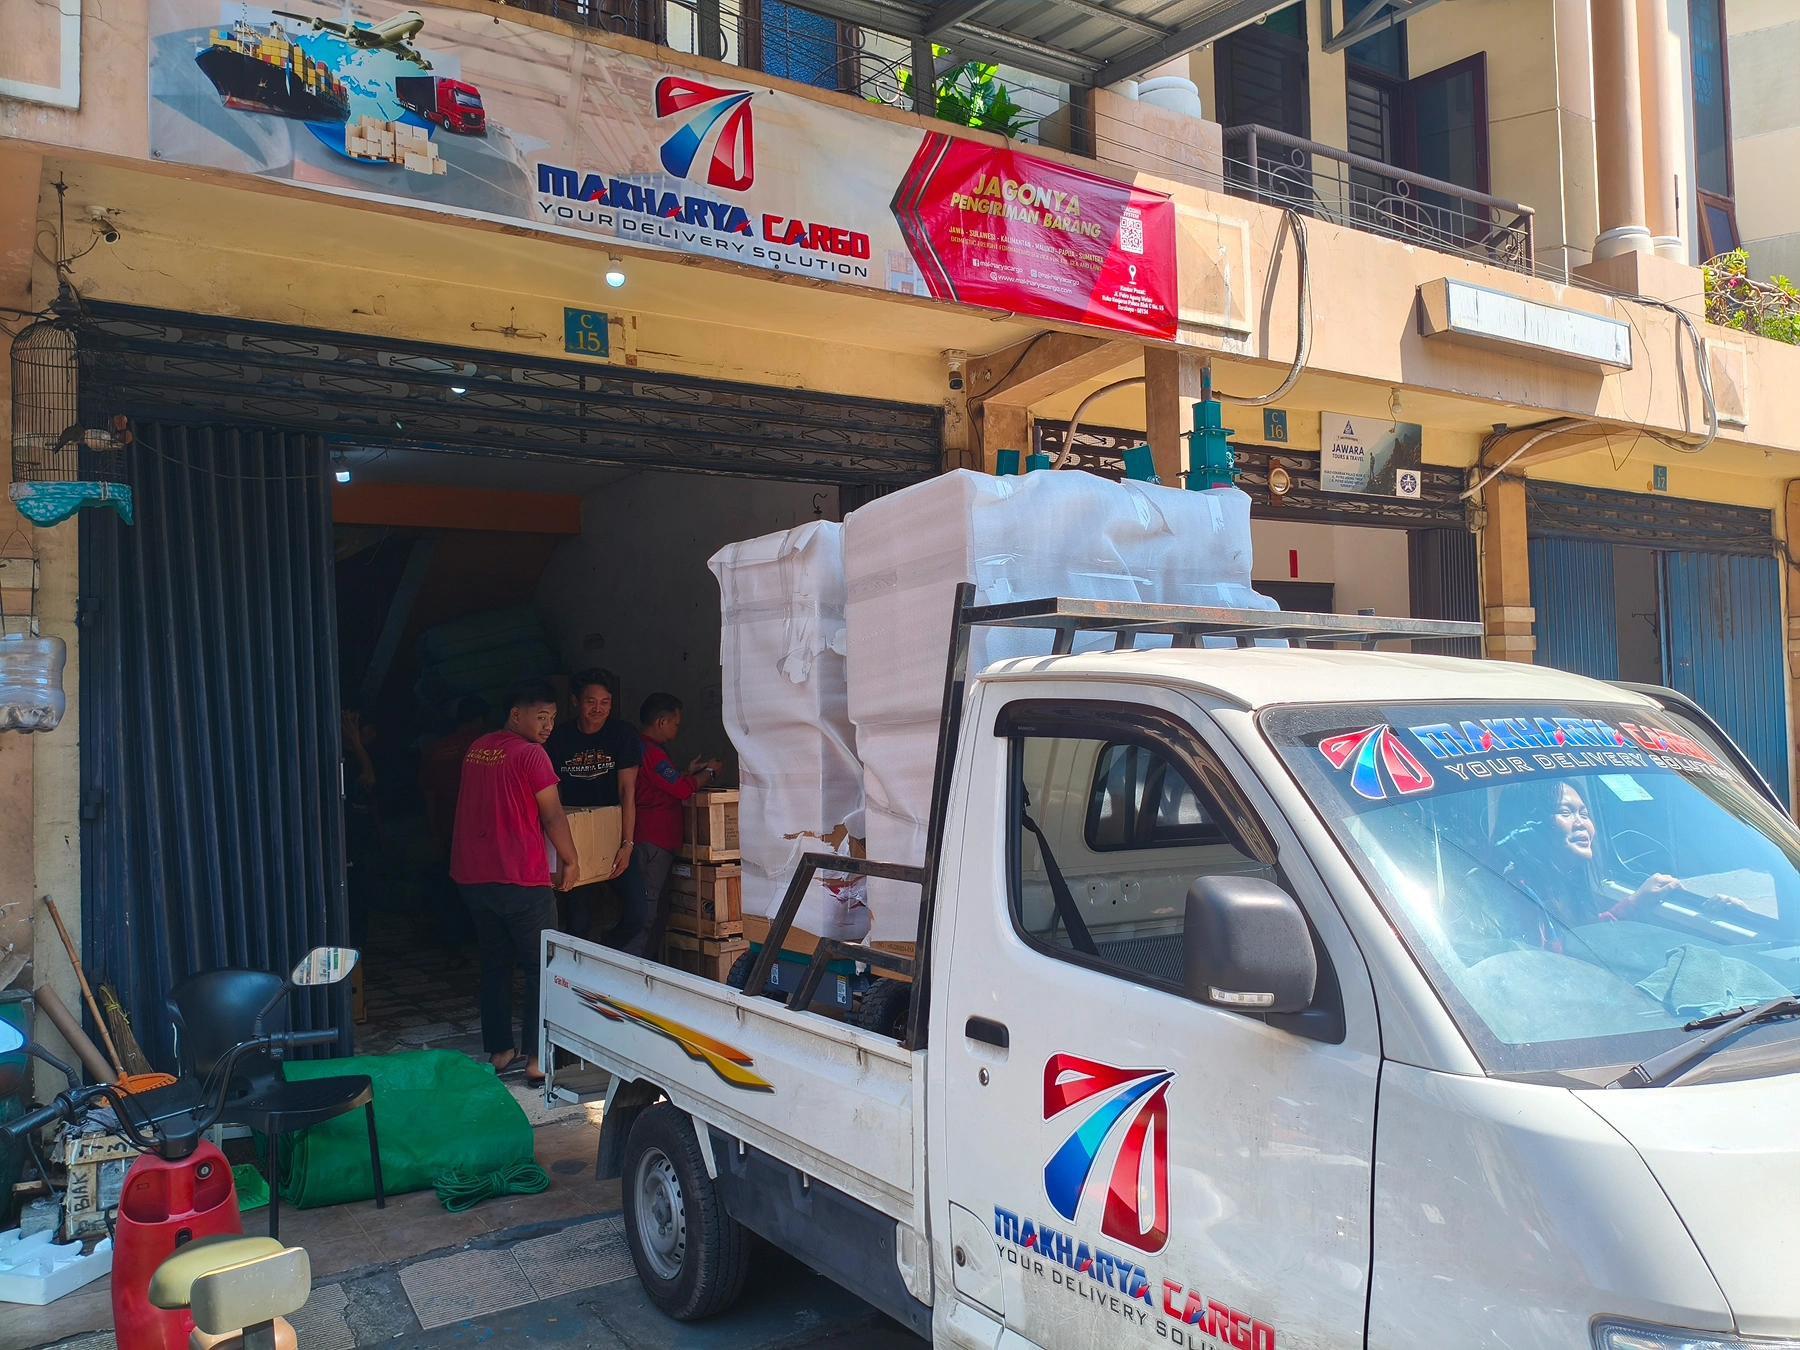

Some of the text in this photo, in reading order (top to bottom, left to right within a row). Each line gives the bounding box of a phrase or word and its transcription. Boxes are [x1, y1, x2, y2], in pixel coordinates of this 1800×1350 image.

[973, 173, 1081, 217] JAGONYA
[537, 163, 871, 260] MAKHARYA CARGO
[950, 192, 1101, 238] PENGIRIMAN BARANG
[538, 201, 867, 278] YOUR DELIVERY SOLUTION
[949, 226, 965, 235] JAWA
[969, 229, 996, 240] SULAWESI
[1059, 248, 1075, 257] PAPUA
[580, 314, 594, 329] C
[575, 330, 601, 352] 15
[1270, 424, 1284, 439] 16
[1271, 412, 1279, 423] C
[1332, 443, 1365, 456] JAWARA
[1657, 476, 1666, 489] 17
[1658, 467, 1663, 477] C
[1408, 717, 1638, 759] MAKHARYA
[1444, 756, 1536, 781] YOUR
[1532, 752, 1649, 770] DELIVERY
[71, 1171, 90, 1212] BIAK
[994, 1204, 1275, 1350] MAKHARYA CARGO
[996, 1243, 1215, 1350] YOUR DELIVERY SOL
